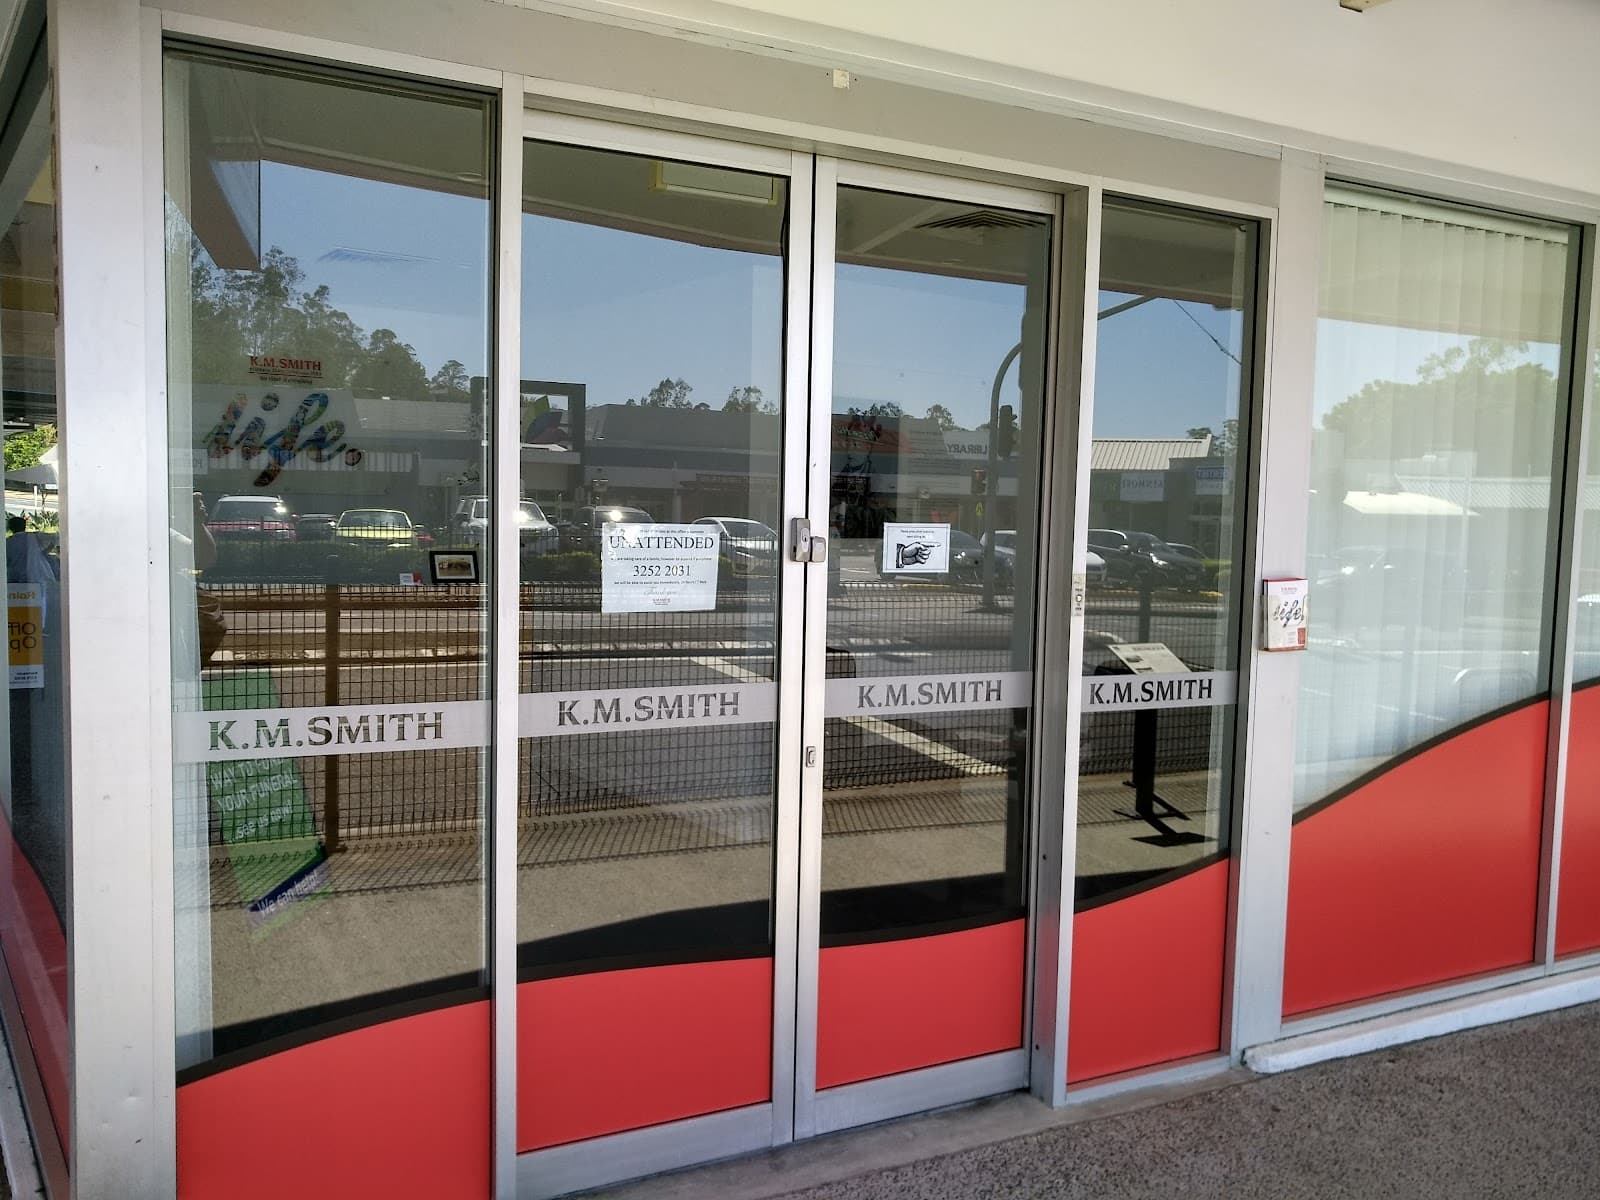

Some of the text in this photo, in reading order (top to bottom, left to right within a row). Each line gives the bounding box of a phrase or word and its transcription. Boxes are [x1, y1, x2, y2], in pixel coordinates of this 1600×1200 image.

[609, 535, 714, 549] UNATTENDED
[633, 565, 691, 577] 3252 2031
[857, 679, 1002, 708] K.M.SMITH
[1089, 678, 1213, 705] K.M.SMITH
[557, 691, 740, 726] K.M.SMITH
[208, 711, 444, 751] K.M.SMITH
[210, 766, 235, 790] WAY
[217, 771, 298, 815] YOUR FUNERAL
[257, 897, 276, 918] We
[277, 887, 295, 906] can
